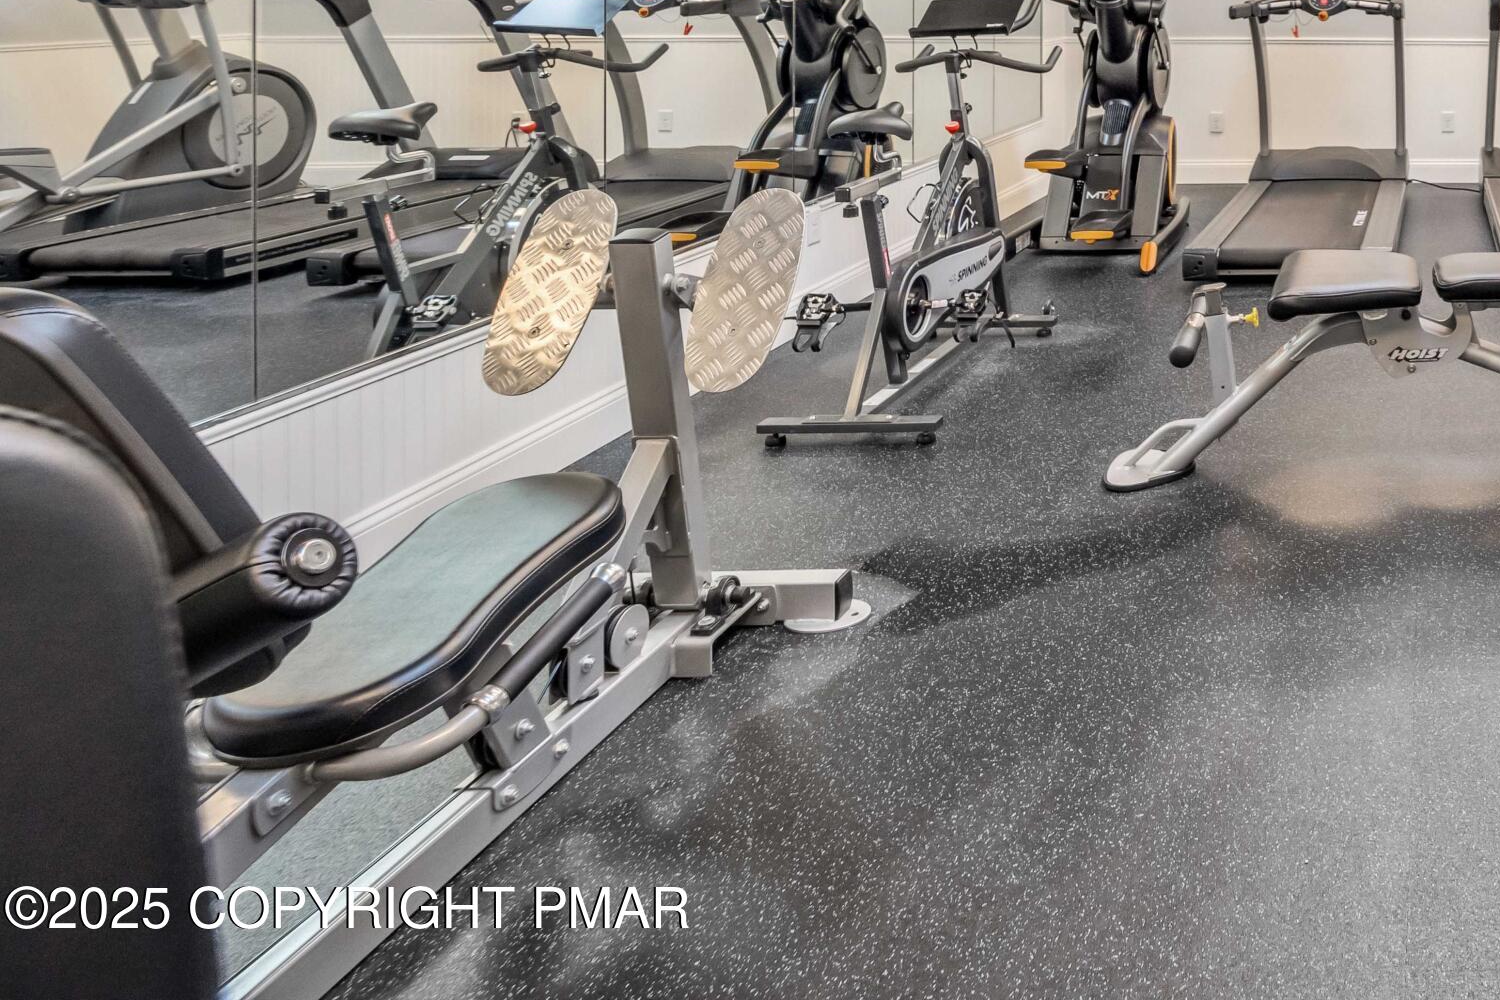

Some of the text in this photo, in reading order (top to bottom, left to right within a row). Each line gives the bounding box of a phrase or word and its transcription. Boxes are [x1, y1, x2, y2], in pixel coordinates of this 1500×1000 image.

[1085, 189, 1121, 200] MTX
[956, 255, 989, 283] SPINNING
[1389, 347, 1449, 361] HOIST
